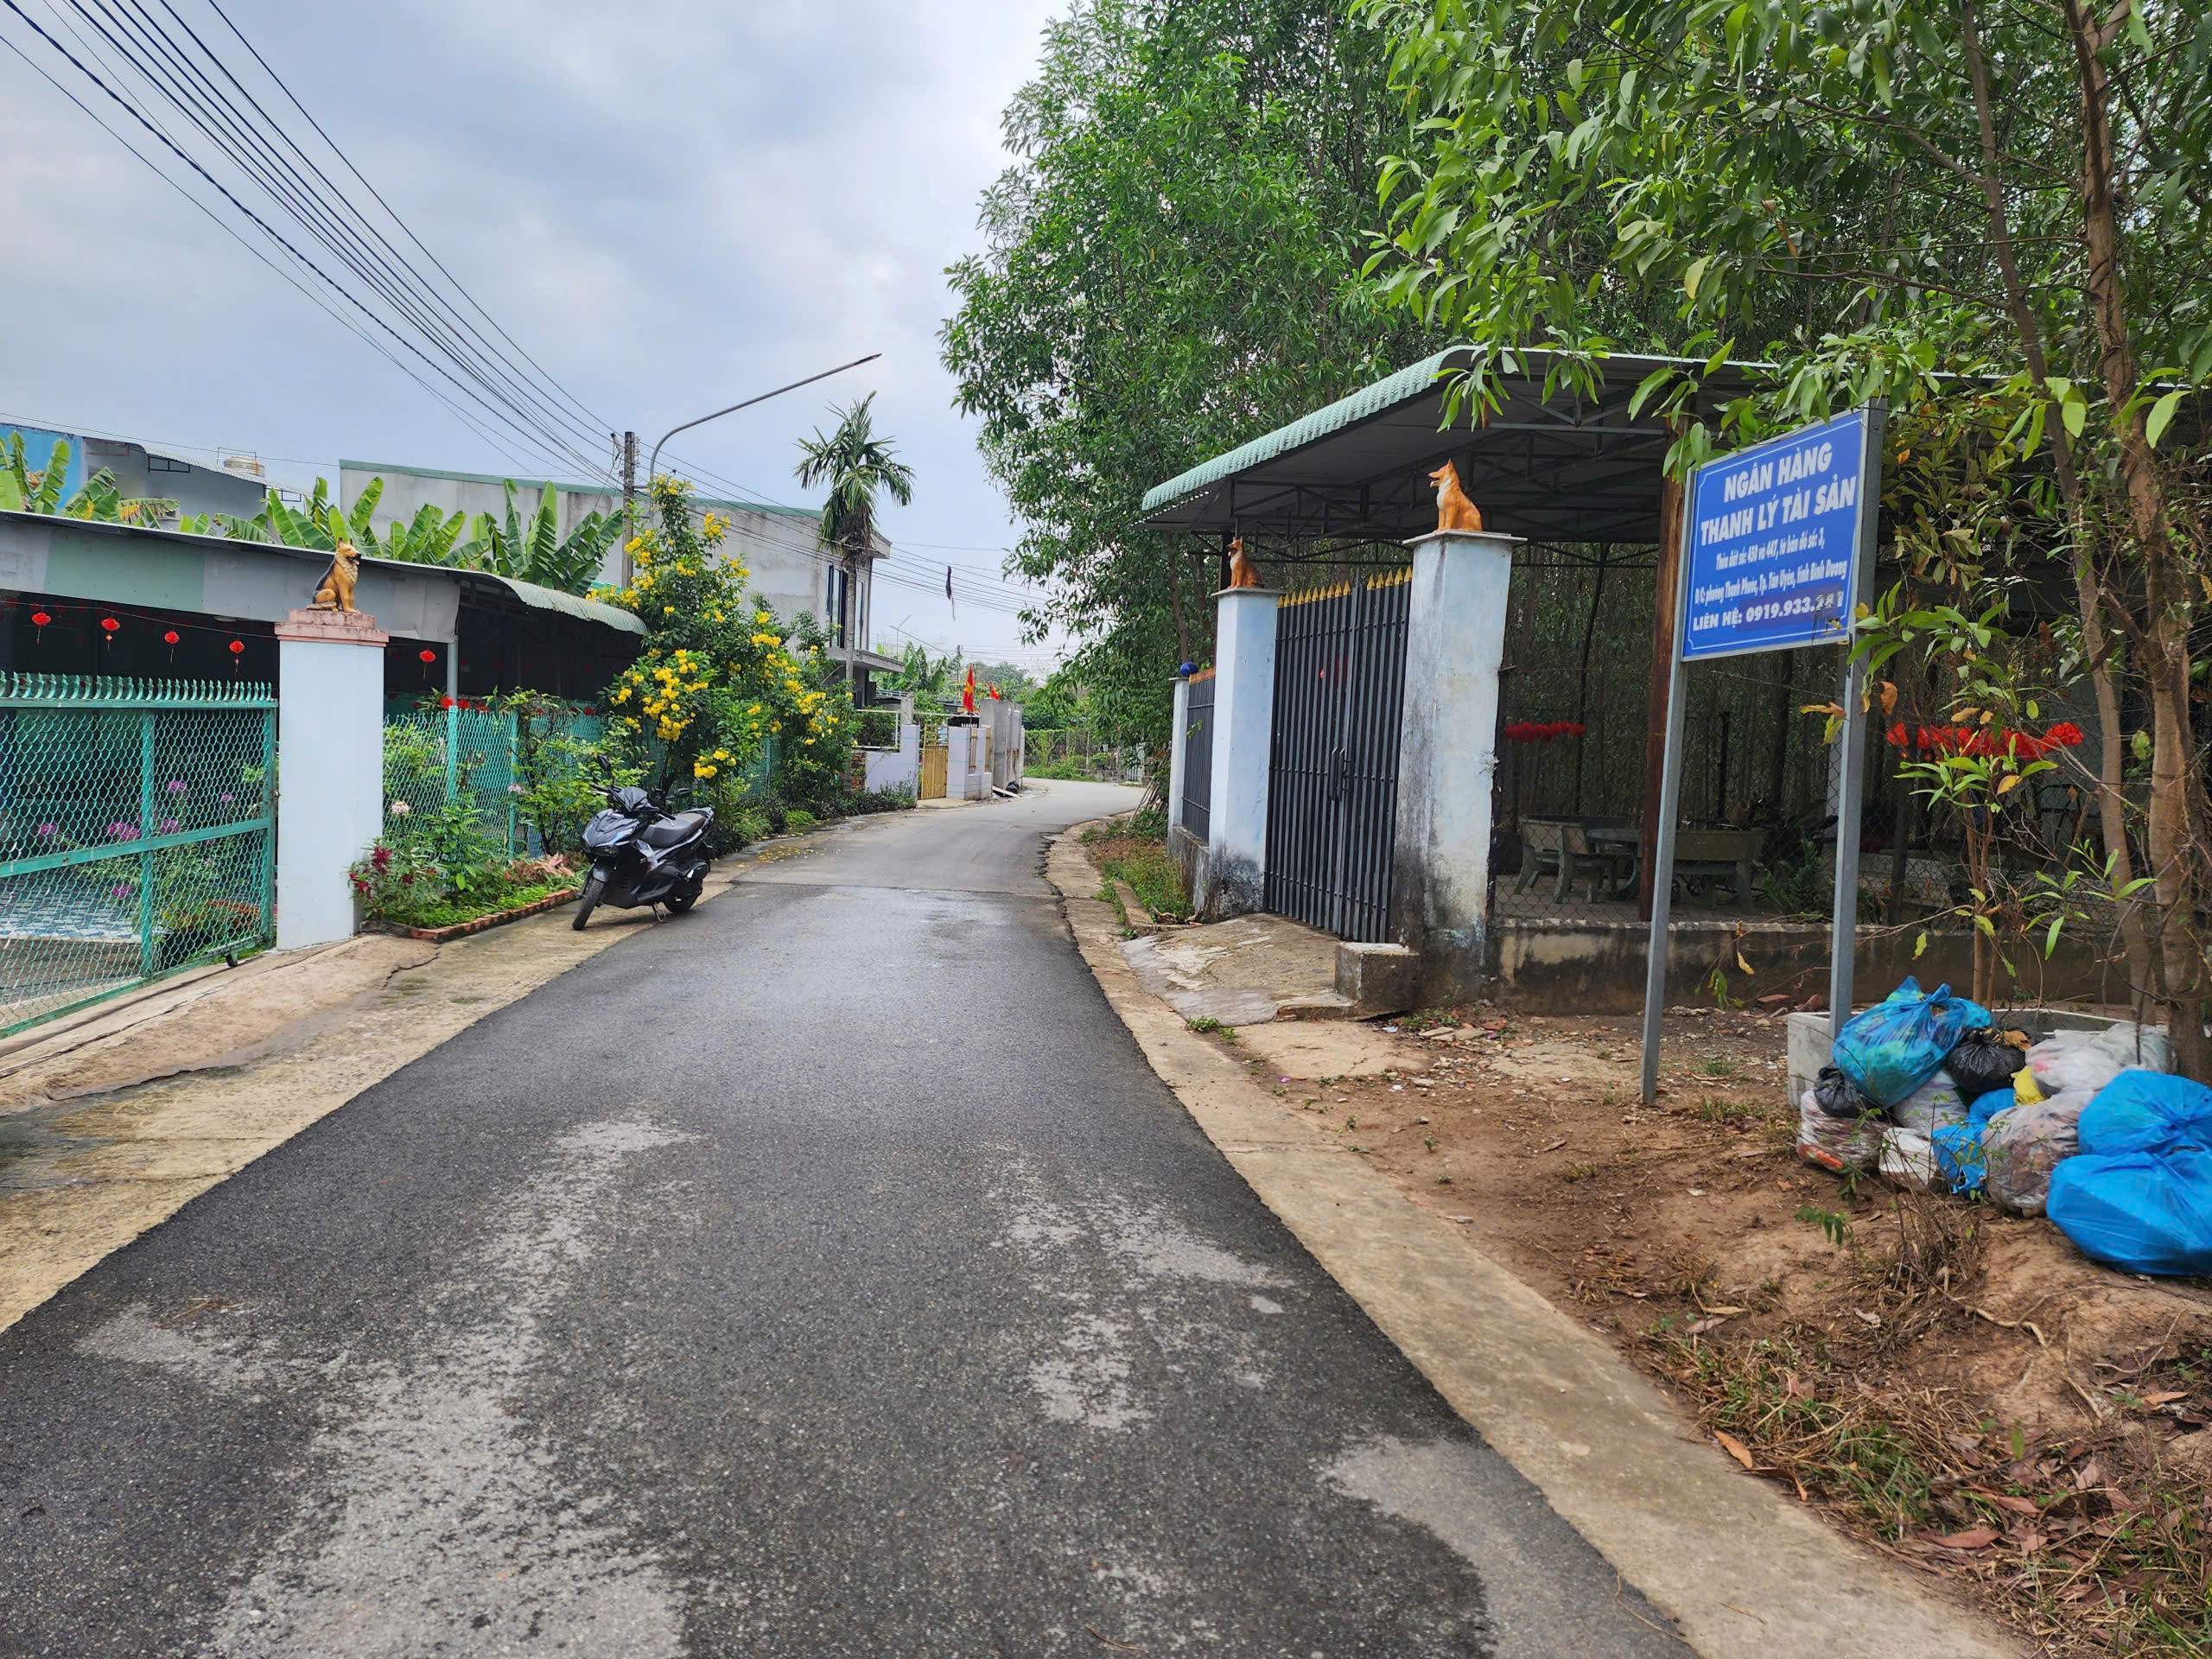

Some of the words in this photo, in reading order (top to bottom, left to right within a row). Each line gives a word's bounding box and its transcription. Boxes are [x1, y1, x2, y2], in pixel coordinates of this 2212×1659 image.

[1724, 462, 1773, 503] NGÂN
[1777, 442, 1833, 486] HÀNG
[1700, 507, 1753, 546] THANH
[1757, 494, 1779, 531] LÝ
[1783, 487, 1811, 524] TÀI
[1814, 474, 1856, 515] SẢN
[1693, 612, 1719, 632] LIÊN
[1721, 607, 1743, 629] HỆ:
